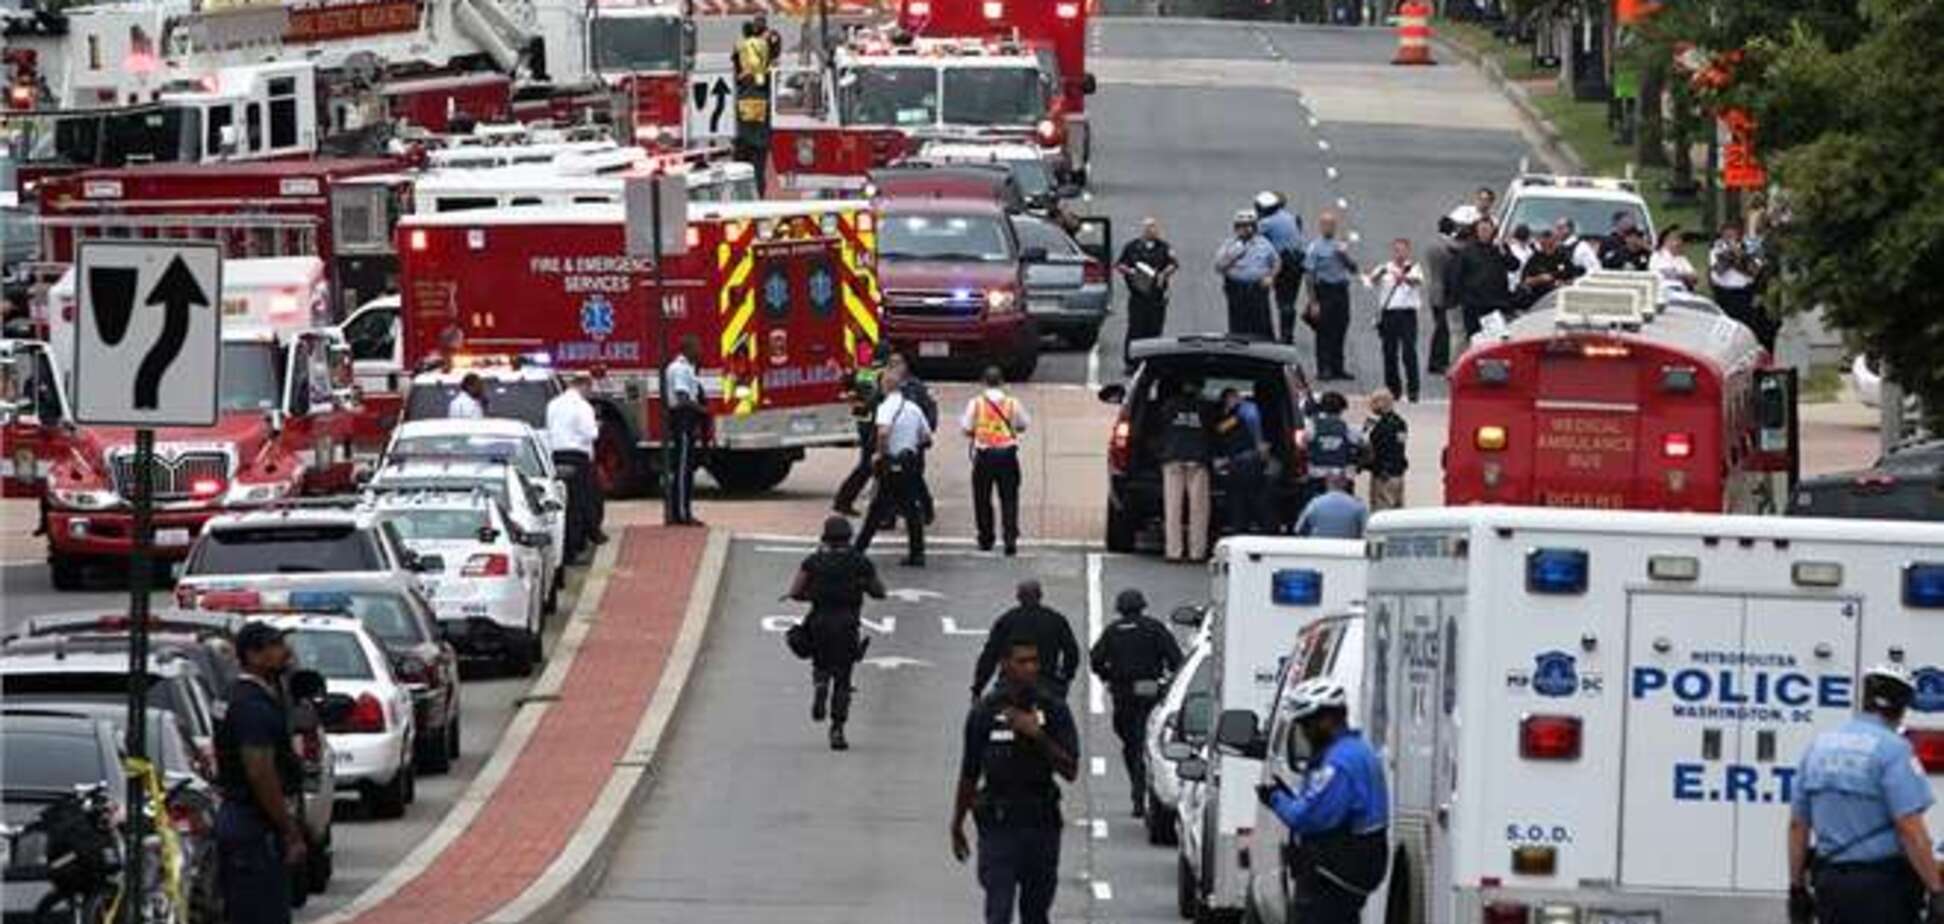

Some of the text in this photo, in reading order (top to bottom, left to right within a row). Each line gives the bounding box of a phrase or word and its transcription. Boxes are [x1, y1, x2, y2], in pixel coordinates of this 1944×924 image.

[530, 256, 560, 273] FIRE
[563, 256, 574, 273] &
[564, 276, 631, 292] SERVICES
[558, 341, 641, 361] AMBULANCE
[1551, 417, 1622, 433] MEDICAL
[1537, 435, 1633, 451] AMBULANCE
[1567, 452, 1602, 469] BUS
[1842, 603, 1855, 618] 4
[1691, 651, 1796, 667] METROPOLITAN
[1632, 667, 1852, 708] POLICE
[1791, 709, 1814, 722] DC
[1507, 824, 1573, 843] S.O.D.
